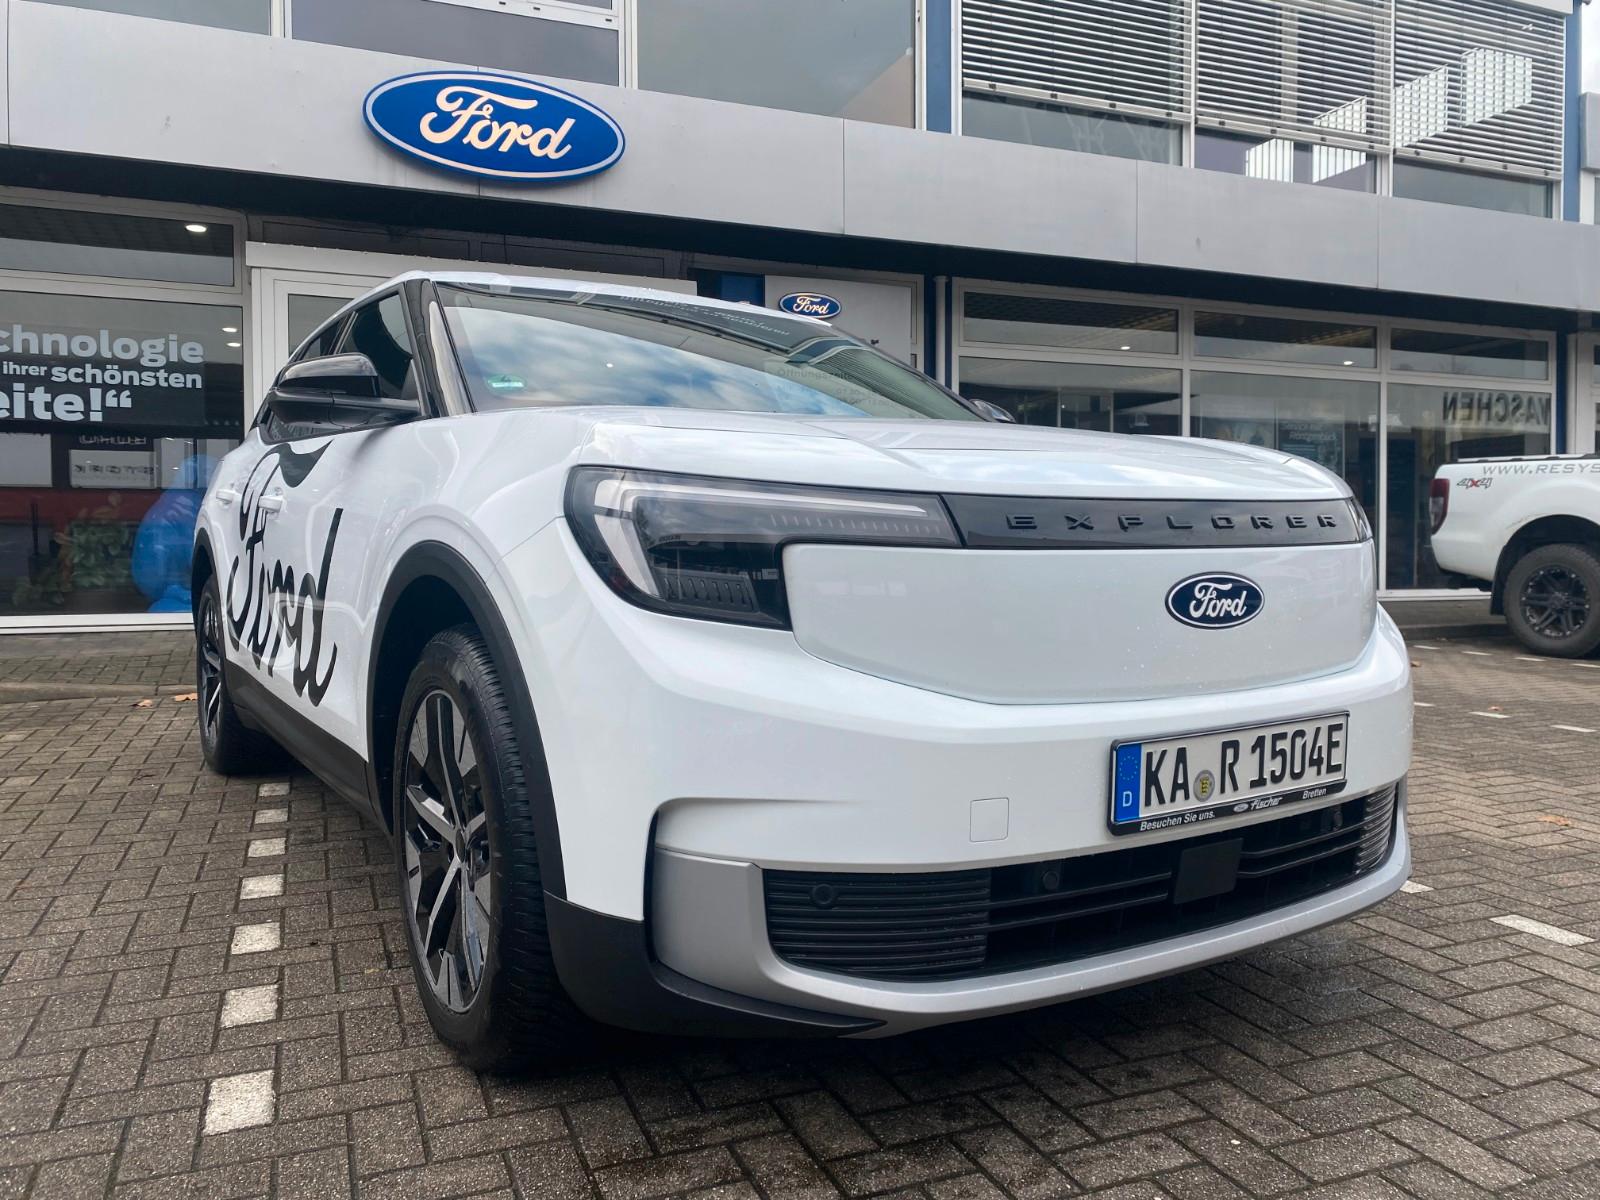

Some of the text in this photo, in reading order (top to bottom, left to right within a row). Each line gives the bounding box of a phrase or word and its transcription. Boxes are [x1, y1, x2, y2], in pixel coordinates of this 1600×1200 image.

[419, 85, 576, 160] Ford
[792, 296, 830, 315] Ford
[3, 361, 202, 388] ihrer schönsten
[1006, 513, 1337, 531] EXPLORER
[227, 438, 343, 707] Ford
[1189, 582, 1247, 618] Ford
[1145, 723, 1344, 807] KA R 1504E
[1122, 791, 1133, 808] D
[1140, 809, 1216, 832] Besuchen Sie uns.
